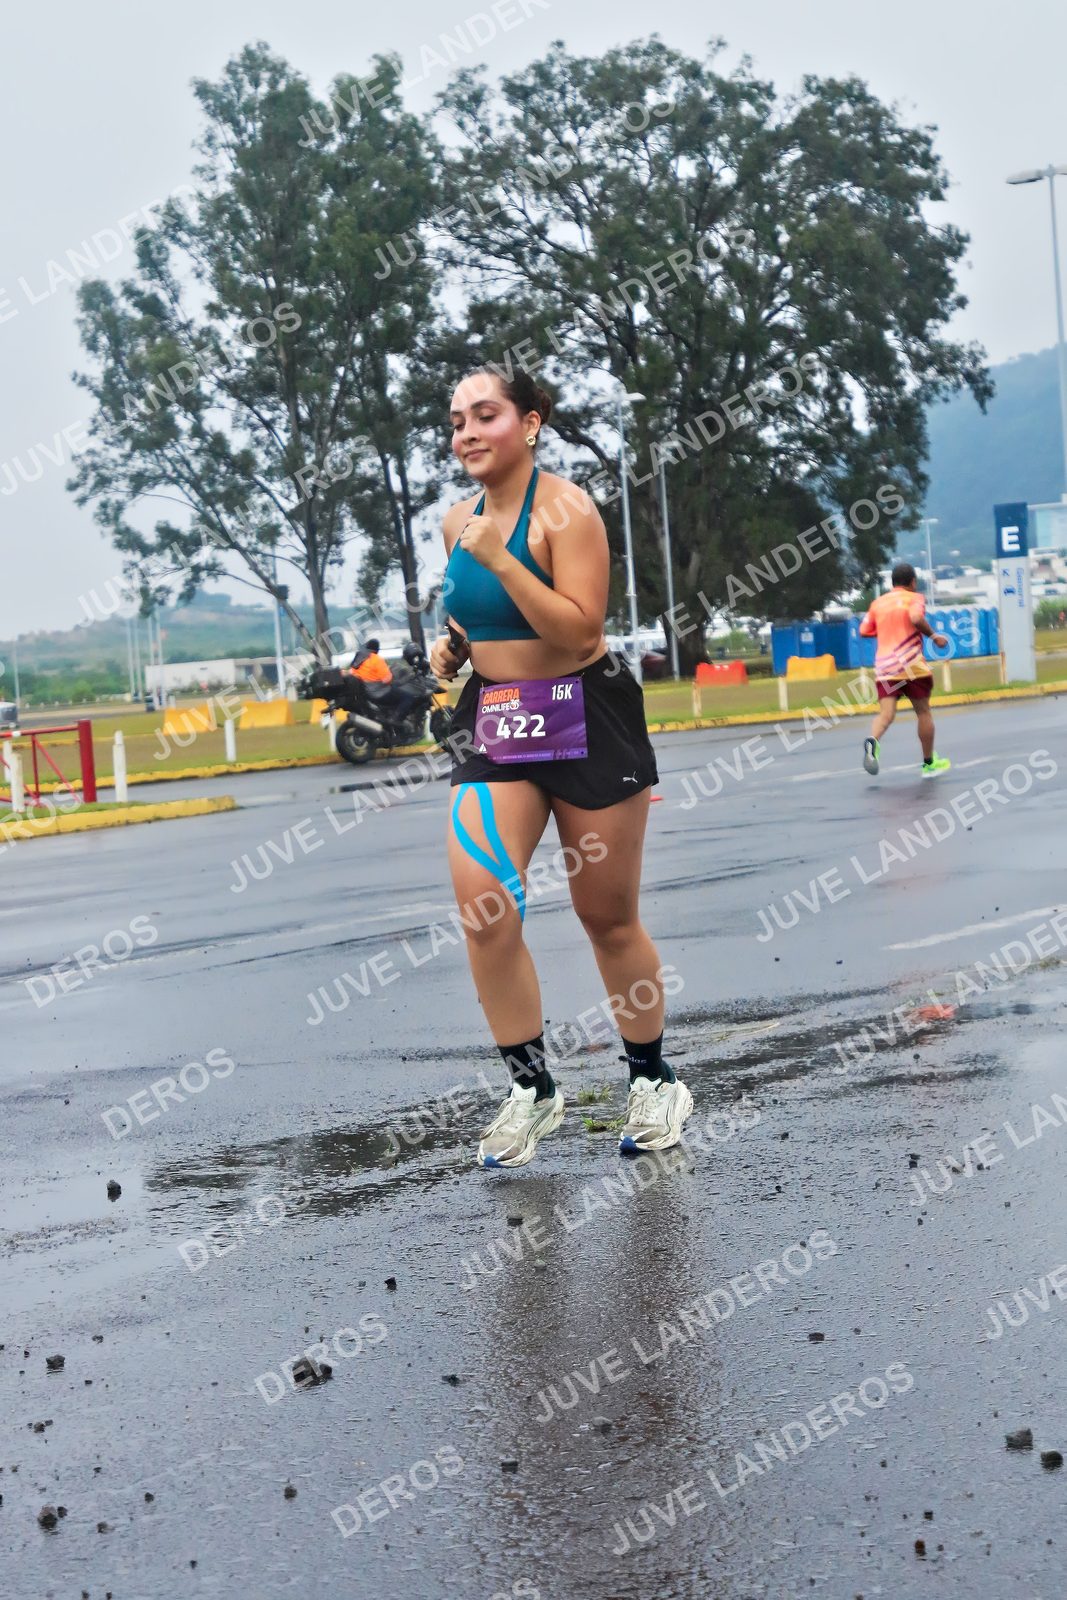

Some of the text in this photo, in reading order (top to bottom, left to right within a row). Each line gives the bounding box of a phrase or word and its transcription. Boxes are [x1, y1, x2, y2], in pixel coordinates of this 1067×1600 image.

[1001, 526, 1021, 552] E
[483, 688, 520, 705] CARRERA
[551, 683, 574, 701] 15K
[482, 702, 510, 714] OMNILIFE
[496, 714, 546, 739] 422
